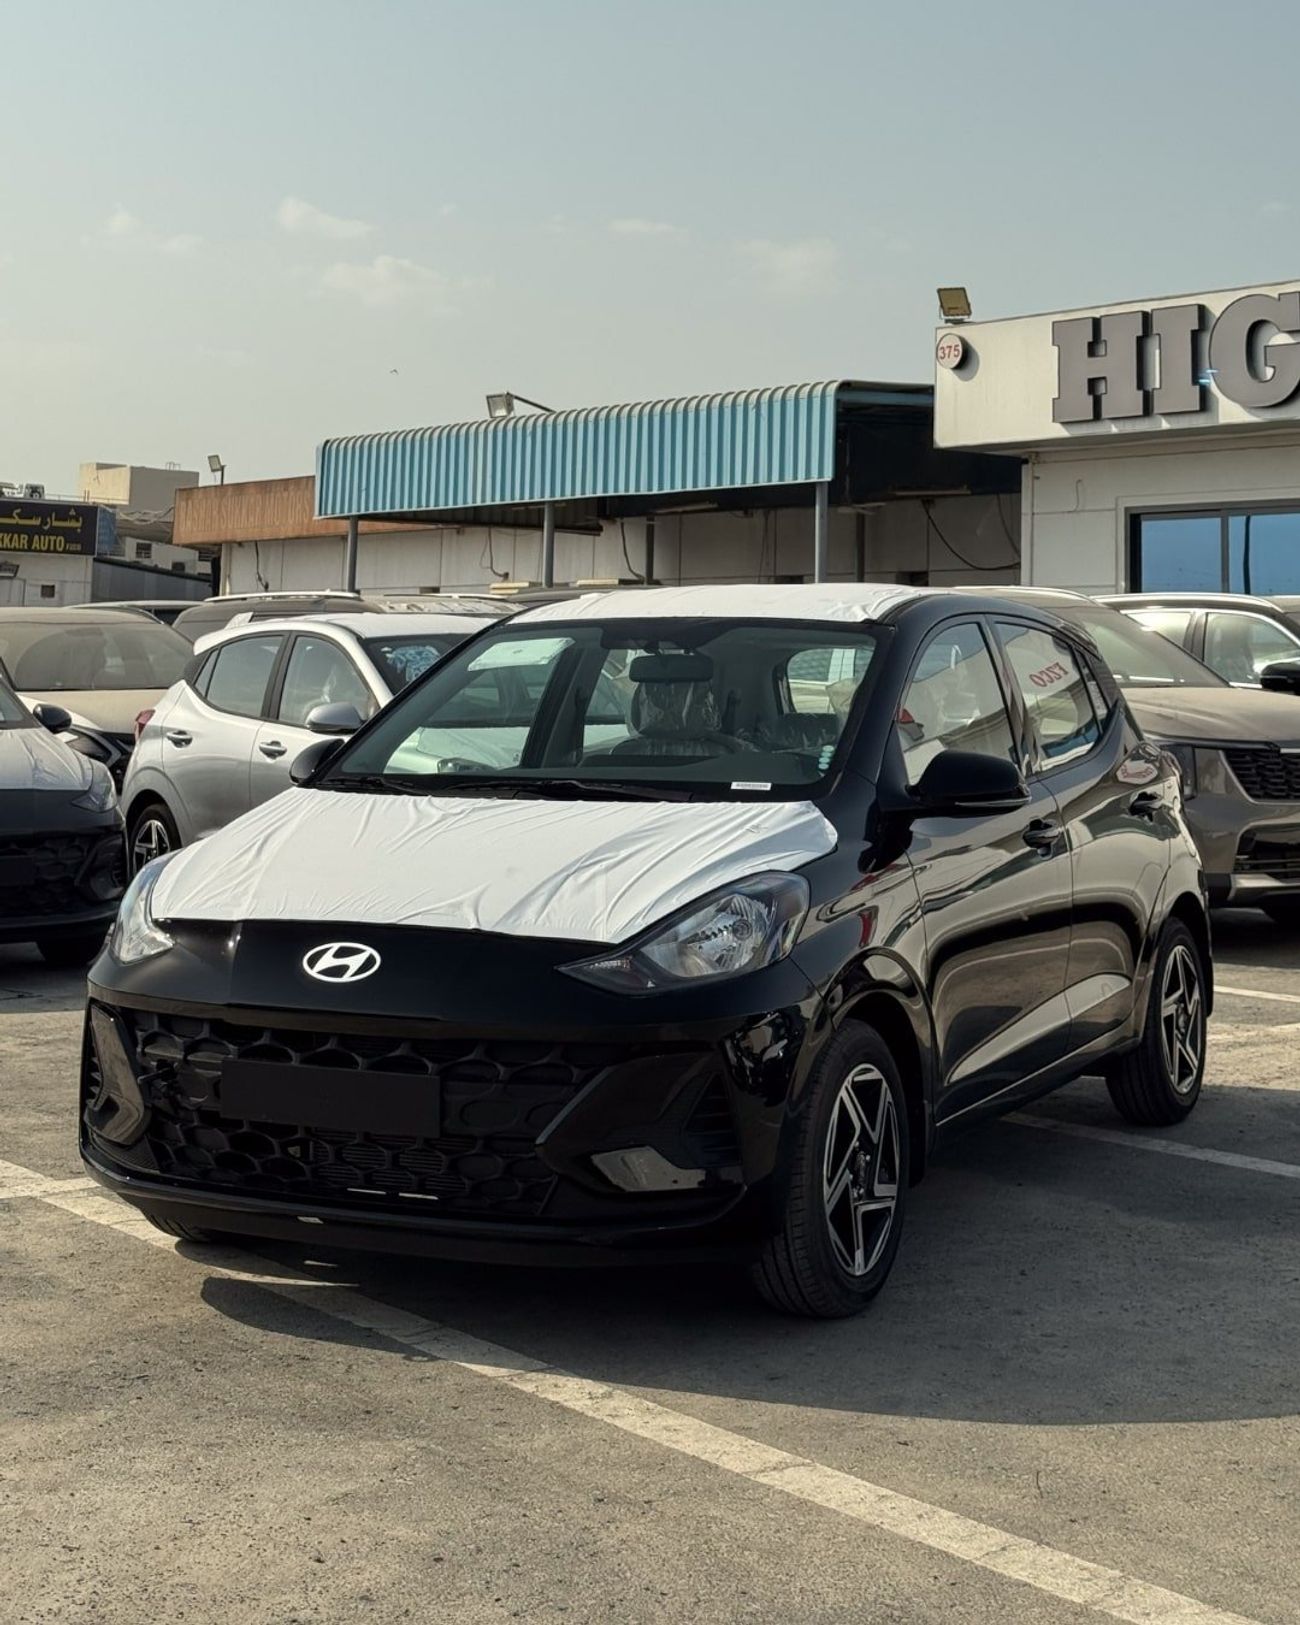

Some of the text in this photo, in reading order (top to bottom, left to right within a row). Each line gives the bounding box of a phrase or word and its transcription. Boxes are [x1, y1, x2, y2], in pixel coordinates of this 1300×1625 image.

[939, 344, 960, 360] 375
[1052, 291, 1300, 423] HIG
[31, 535, 65, 551] AUTO
